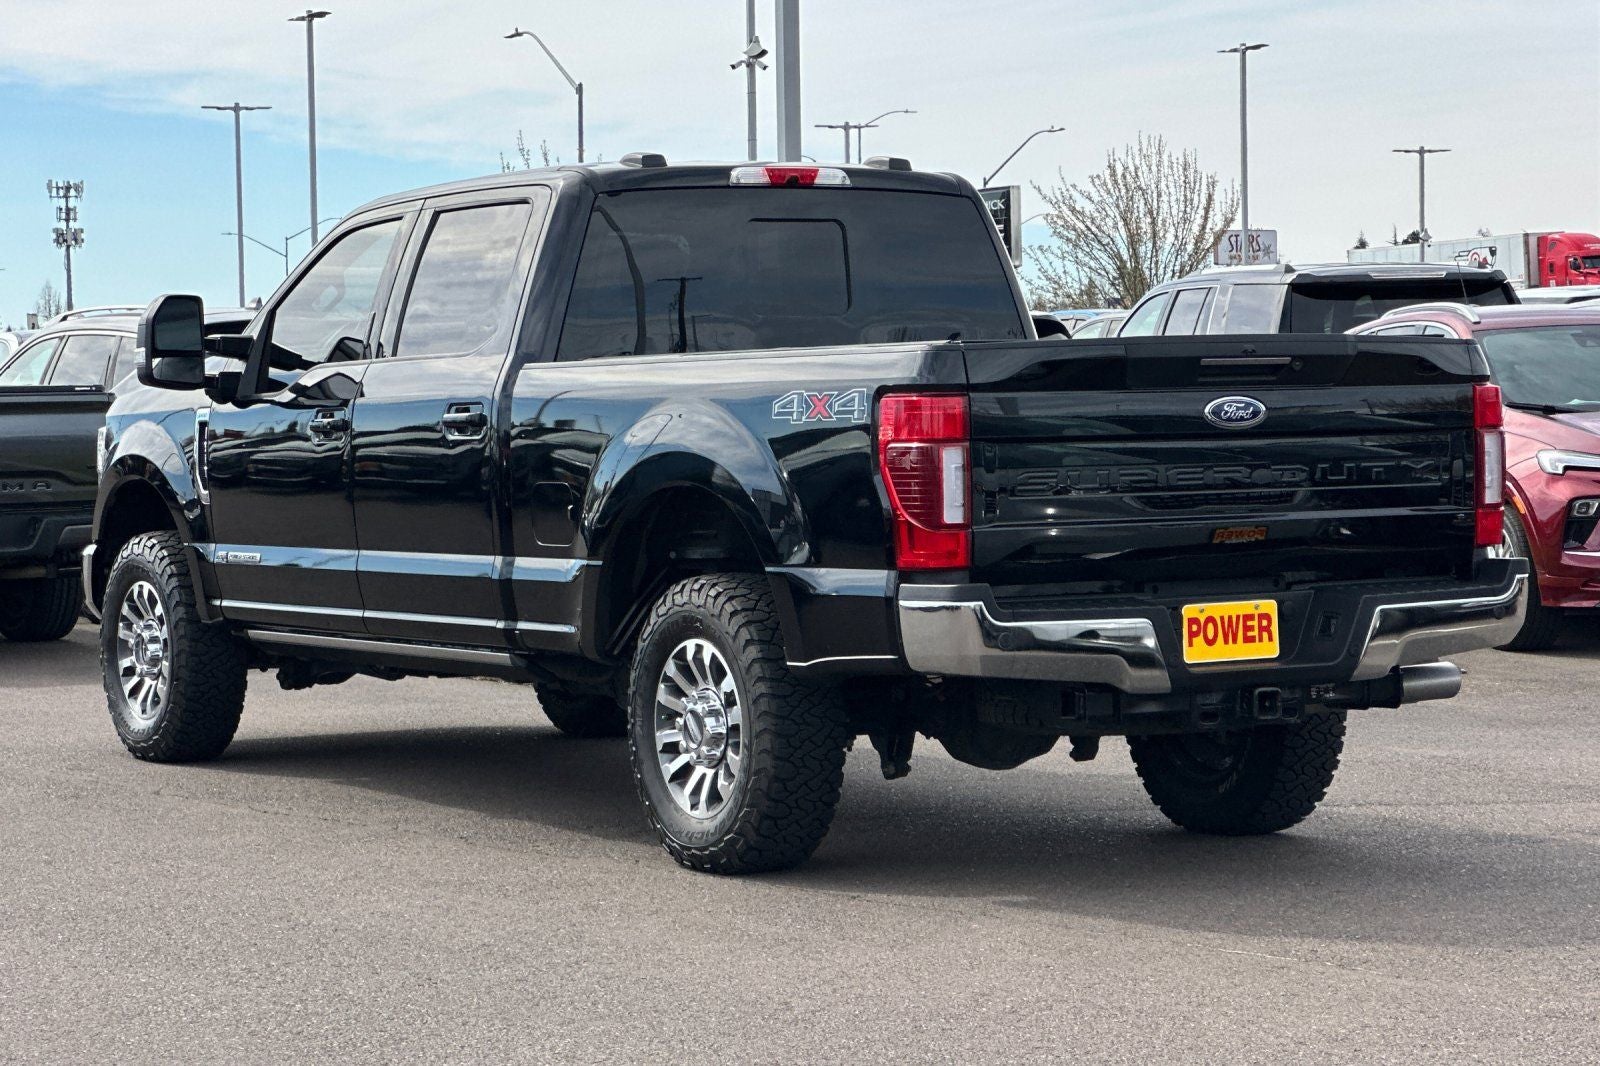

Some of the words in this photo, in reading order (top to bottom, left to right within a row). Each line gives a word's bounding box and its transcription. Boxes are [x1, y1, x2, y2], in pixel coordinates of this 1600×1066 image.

[1221, 402, 1254, 420] Ford
[1011, 466, 1252, 497] SUPER
[1269, 460, 1440, 486] DUTY
[1187, 612, 1274, 648] POWER
